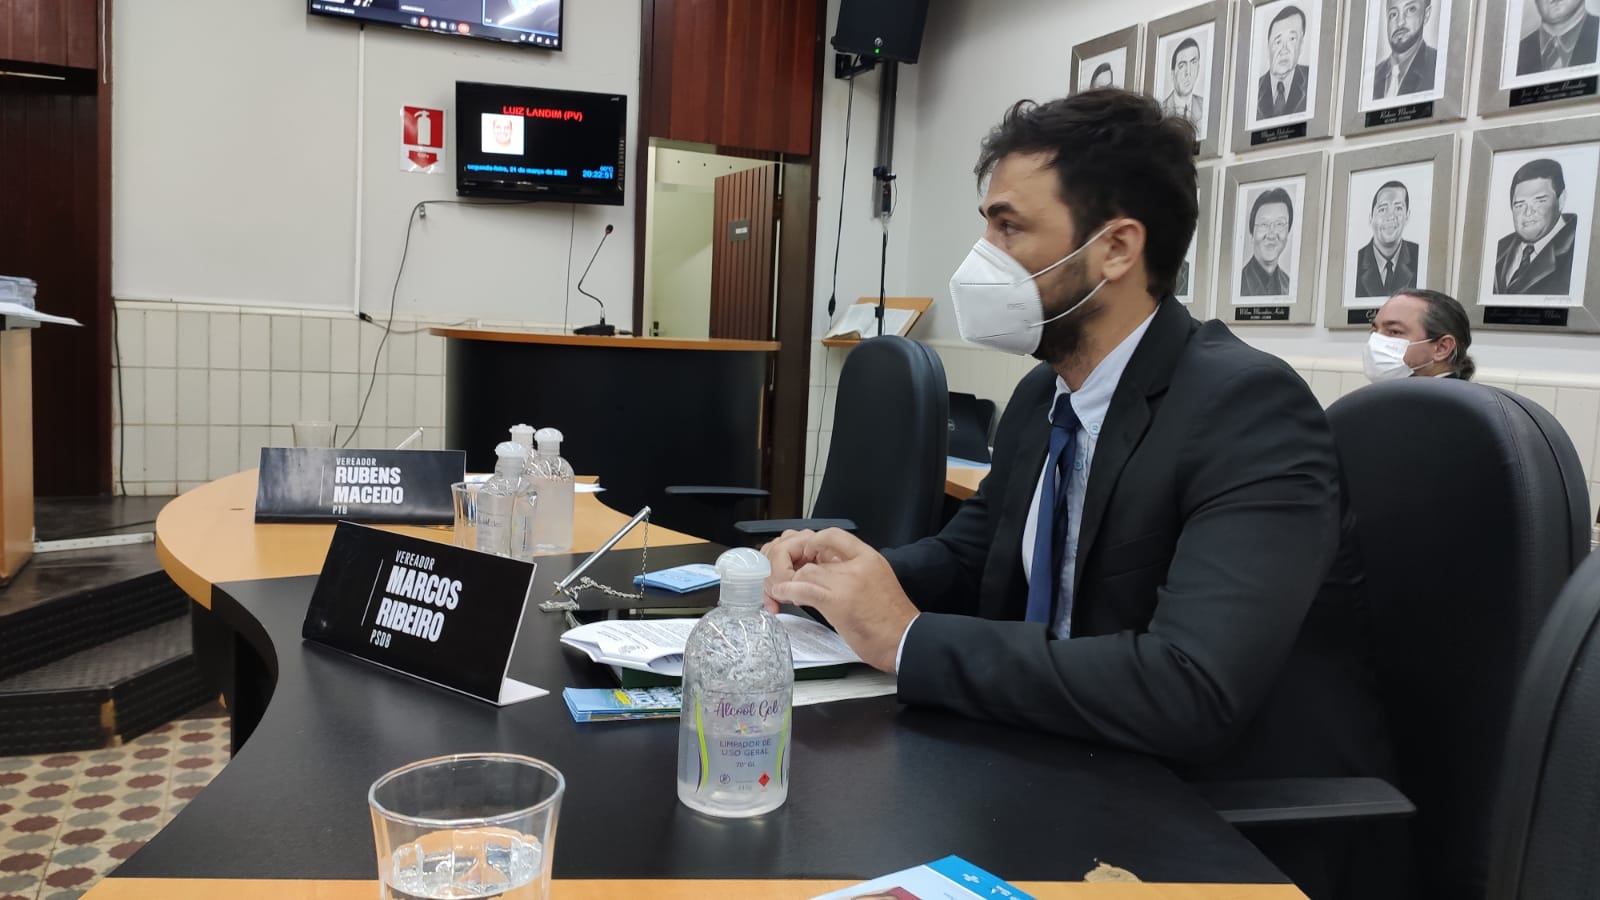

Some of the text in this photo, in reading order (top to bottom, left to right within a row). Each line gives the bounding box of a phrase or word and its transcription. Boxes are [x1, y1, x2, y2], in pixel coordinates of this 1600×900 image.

[502, 105, 584, 123] LUIZ LANDIM (PV)
[335, 457, 377, 466] VEREADOR
[334, 466, 401, 484] RUBENS
[332, 485, 404, 505] MACEDO
[332, 505, 348, 515] PTB
[394, 550, 436, 571] VEREADOR
[385, 565, 463, 610] MARCOS
[375, 597, 446, 643] RIBEIRO
[369, 629, 392, 649] PSDB
[758, 699, 779, 721] Gel
[719, 739, 761, 748] LIMPADOR
[743, 748, 768, 756] GERAL
